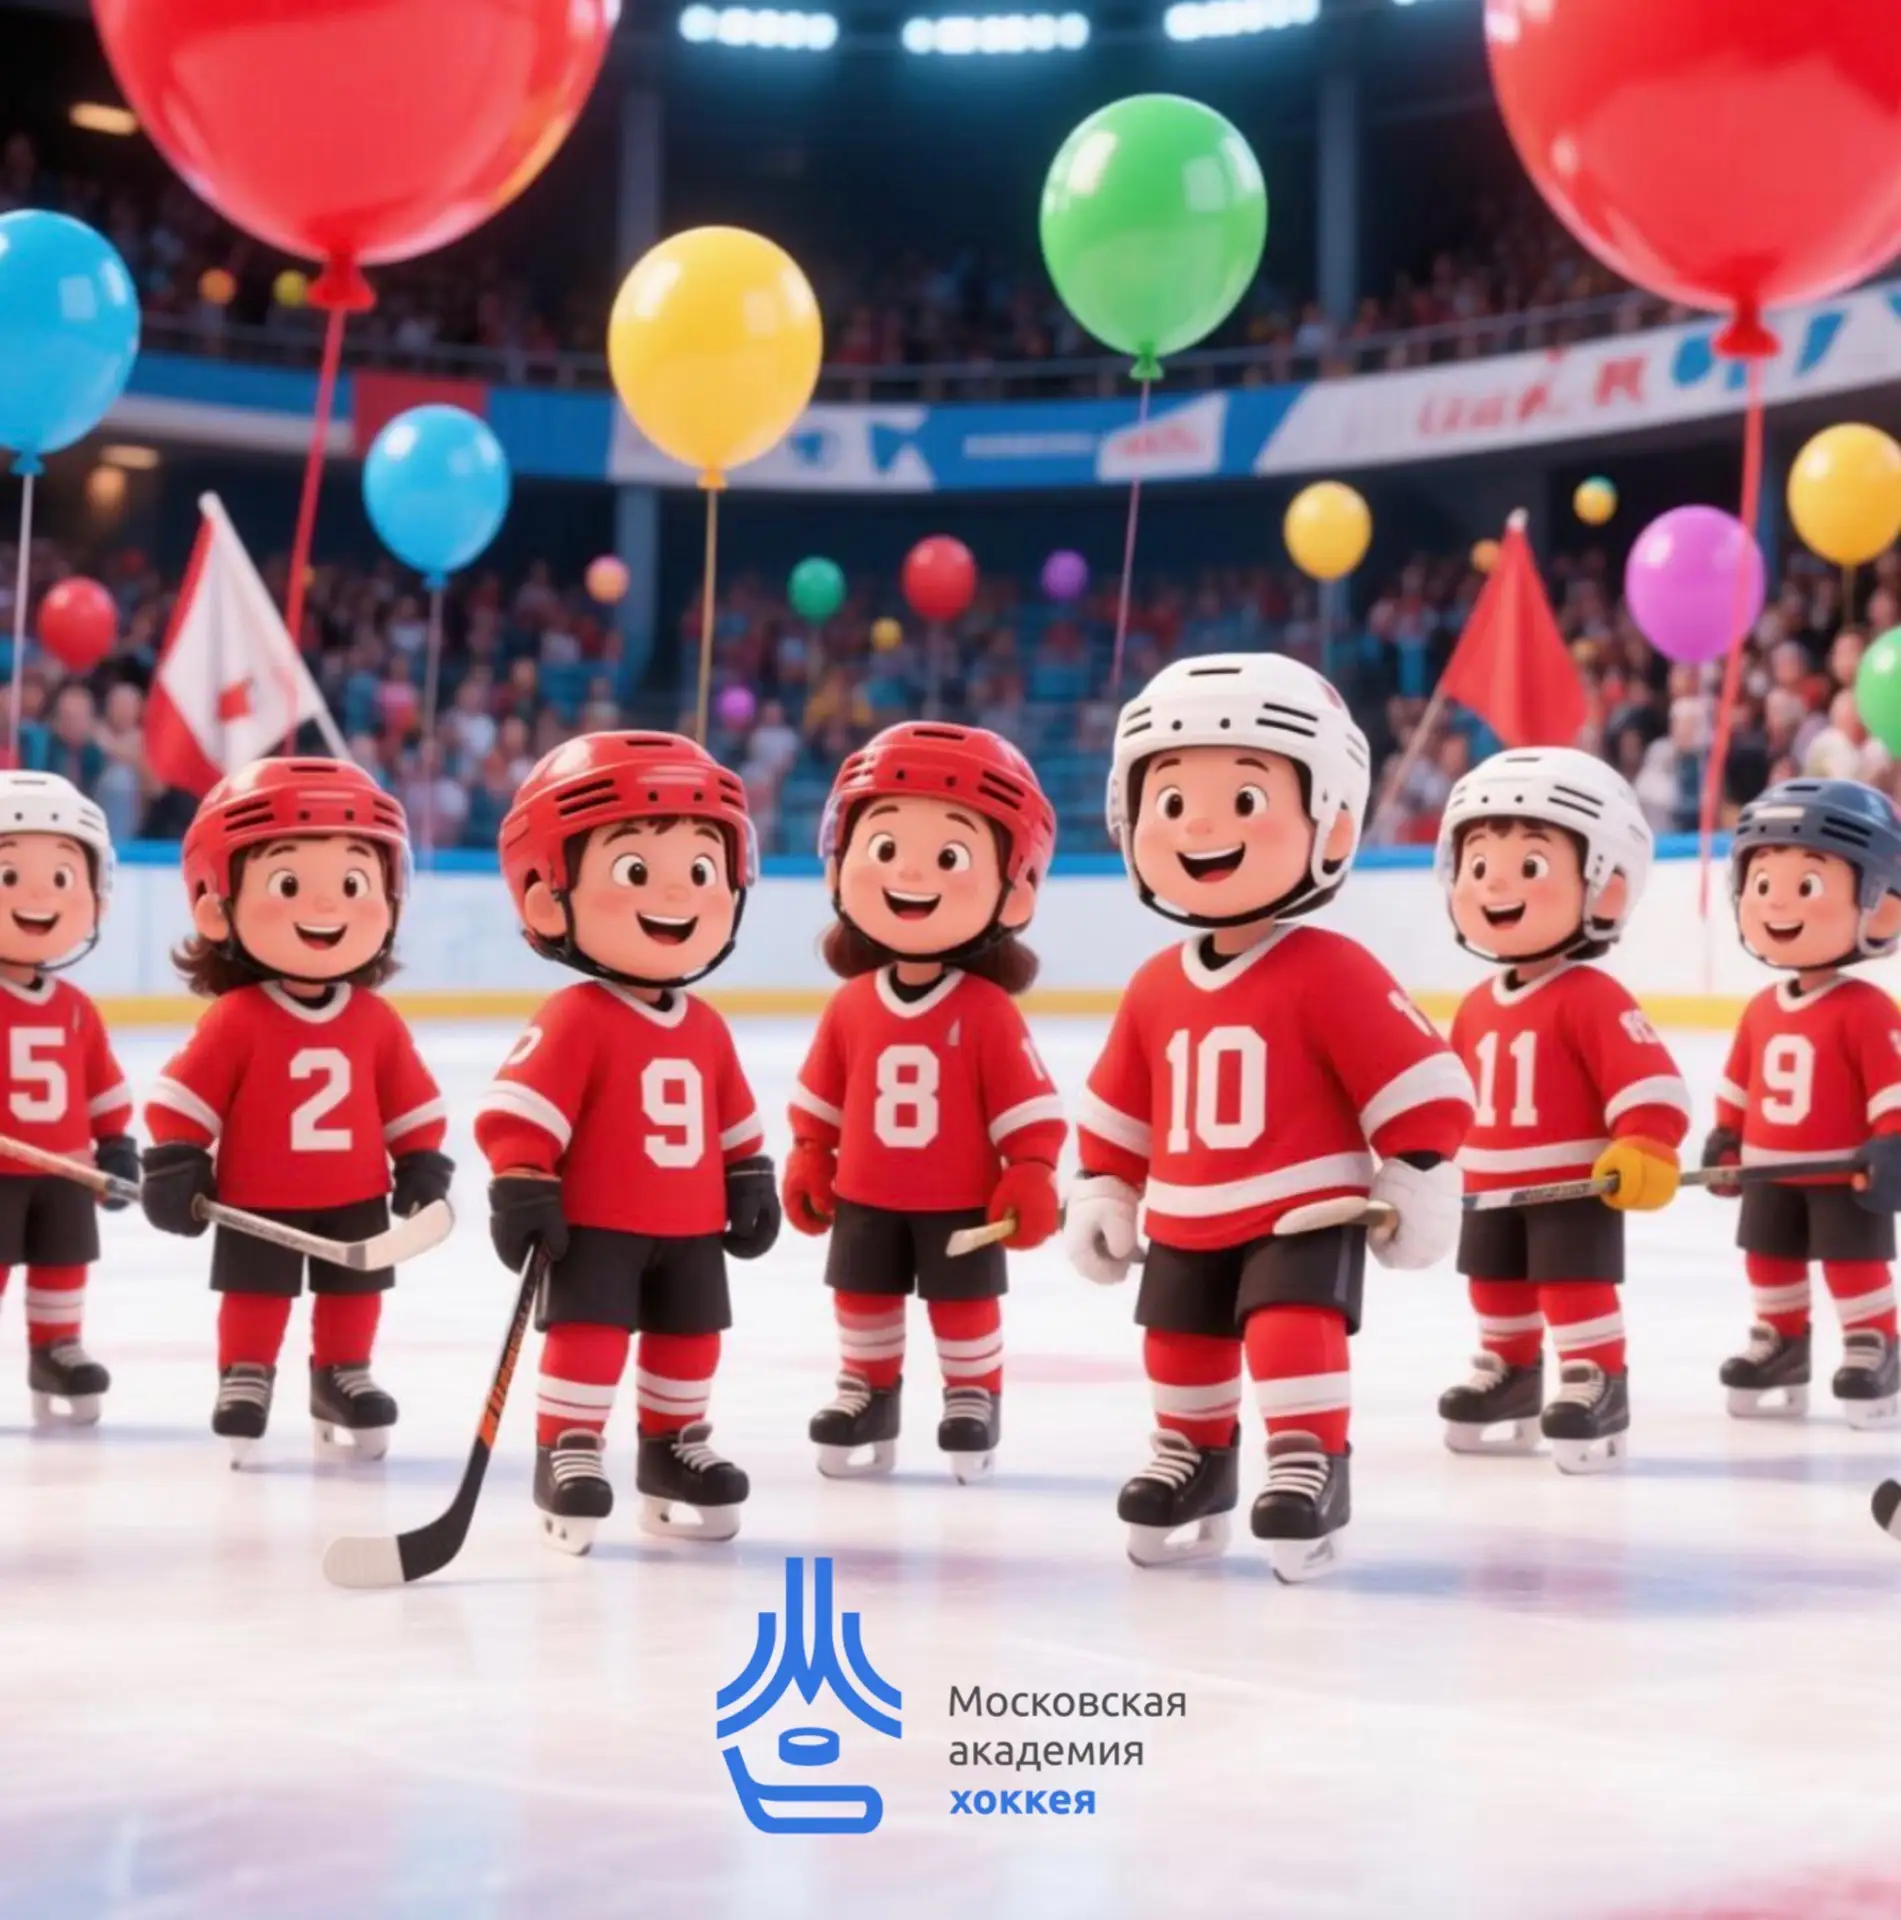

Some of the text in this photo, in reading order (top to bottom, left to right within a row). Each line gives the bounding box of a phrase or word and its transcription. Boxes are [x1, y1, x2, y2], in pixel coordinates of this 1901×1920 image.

[8, 1026, 68, 1122] 5
[289, 1048, 352, 1151] 2
[640, 1057, 705, 1168] 9
[874, 1044, 940, 1148] 8
[1165, 1025, 1267, 1155] 10
[1474, 1030, 1538, 1127] 11
[1760, 1032, 1816, 1126] 9
